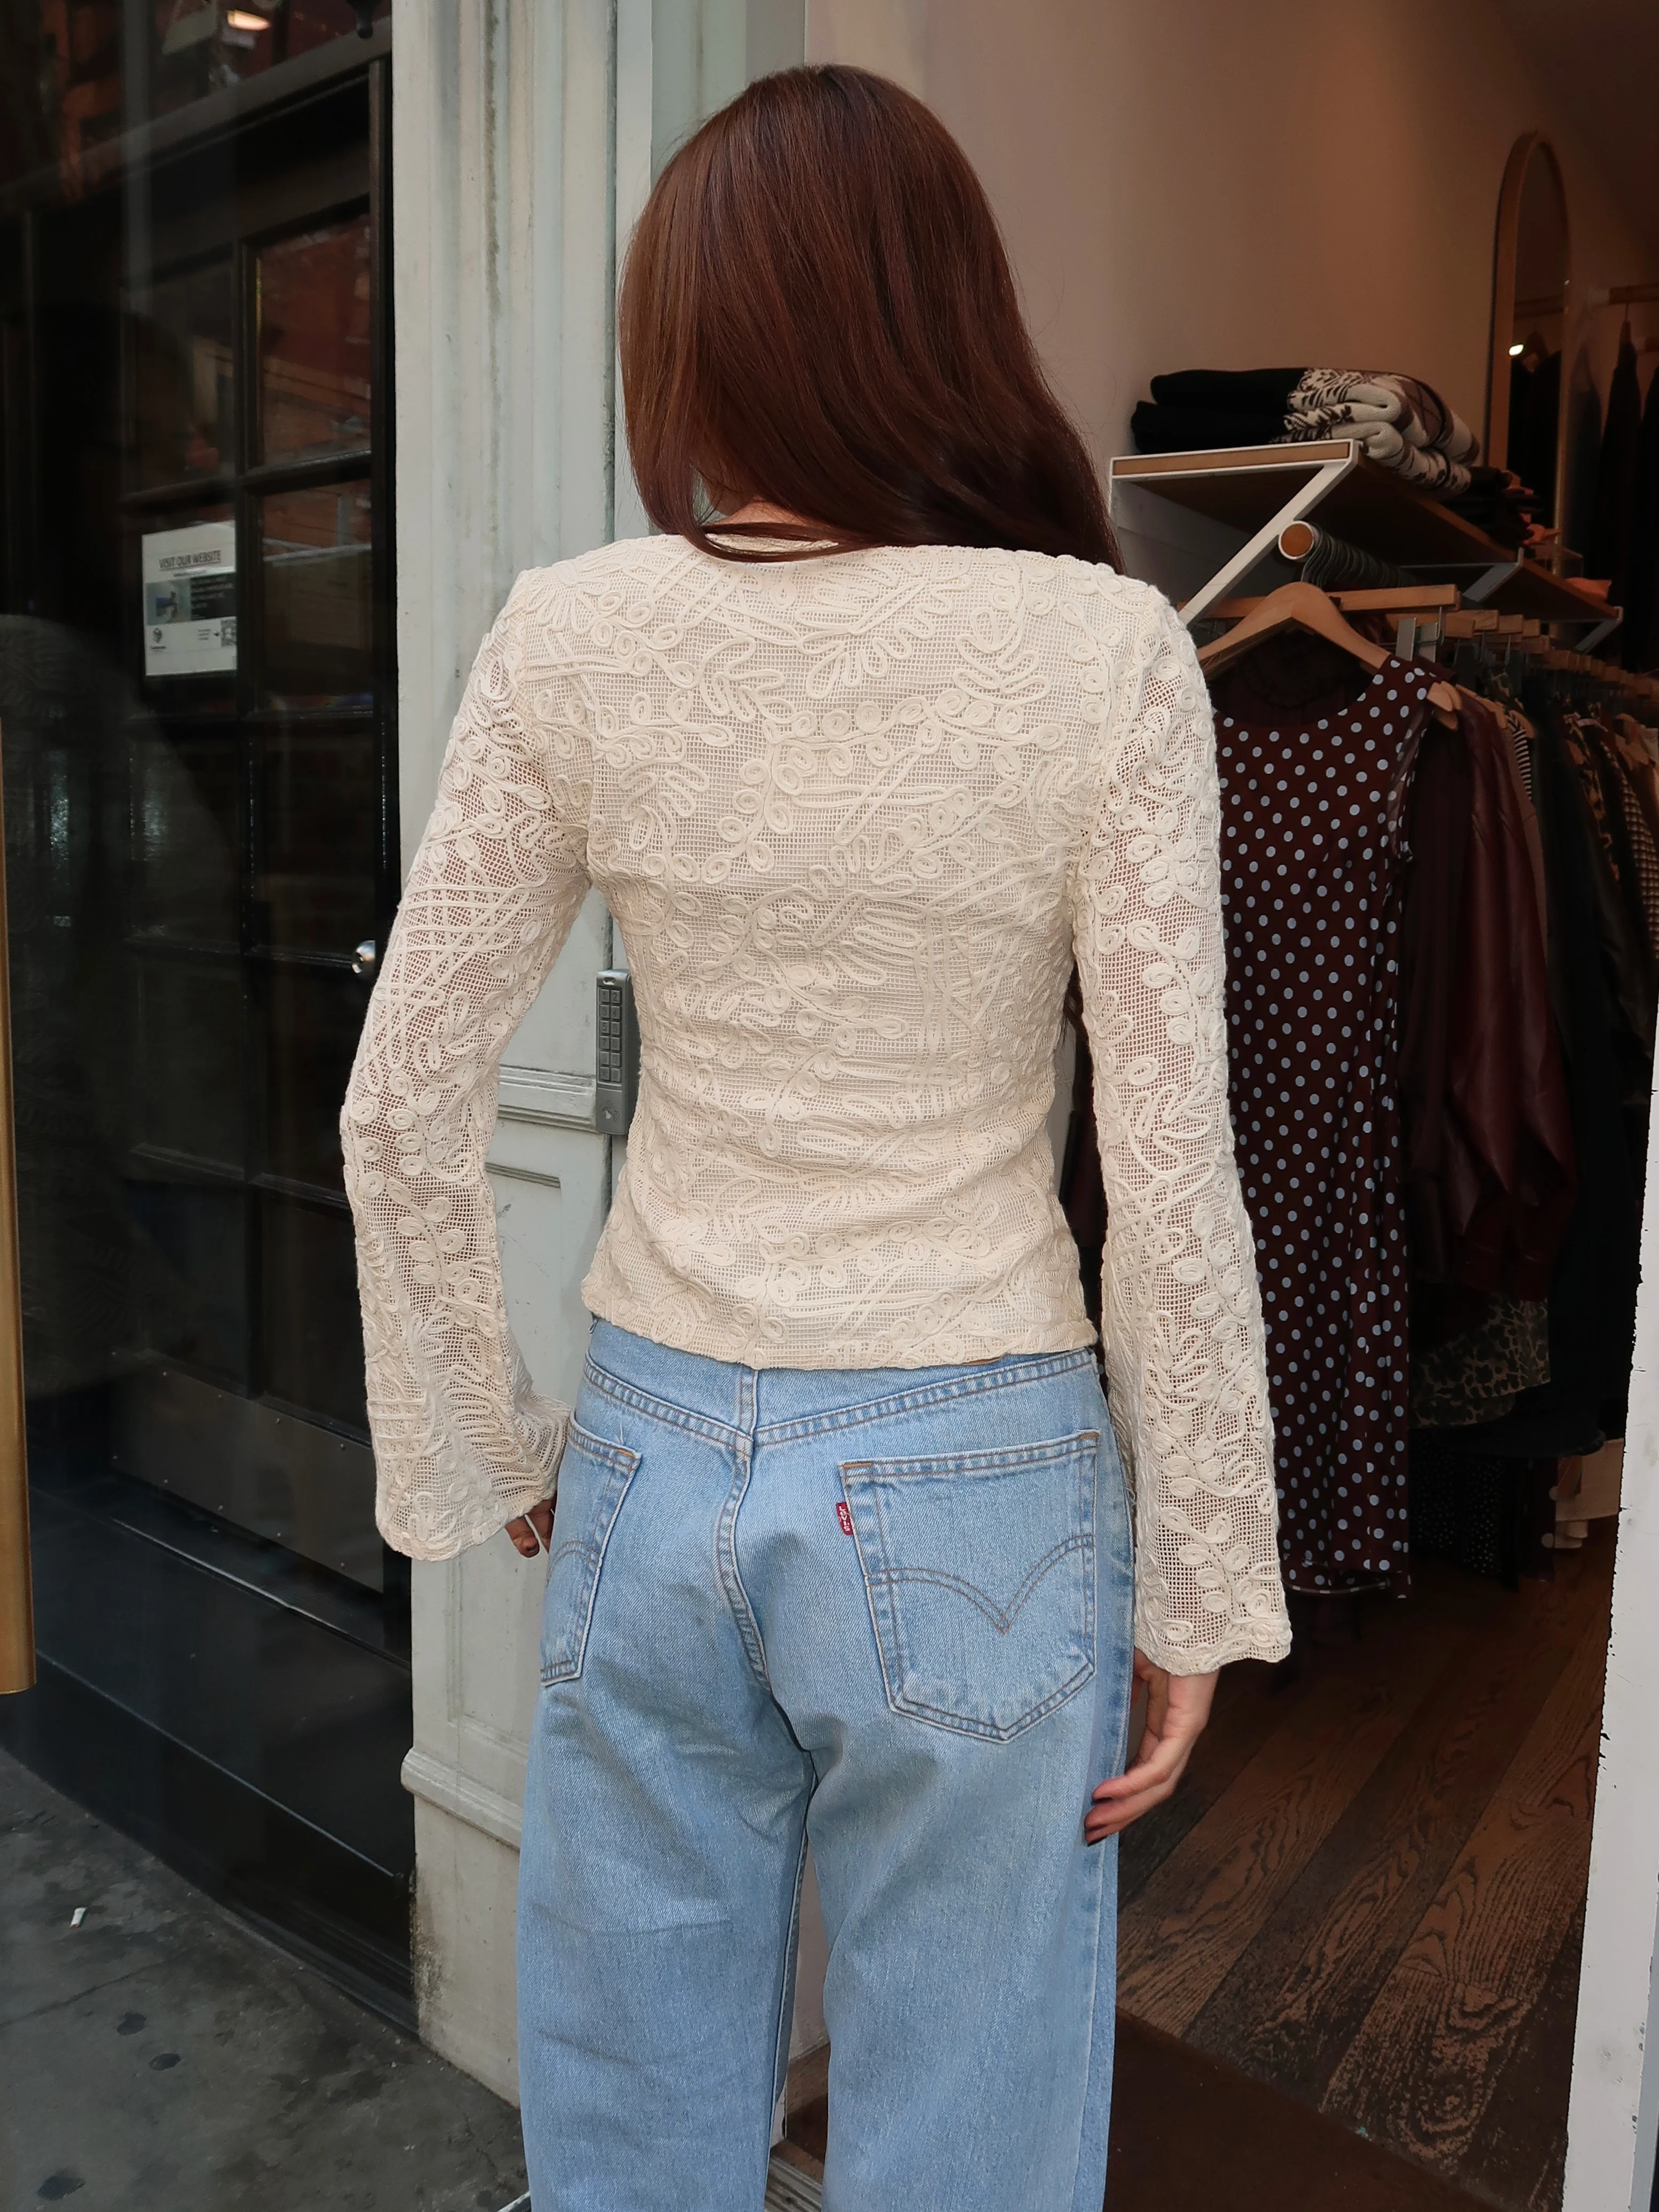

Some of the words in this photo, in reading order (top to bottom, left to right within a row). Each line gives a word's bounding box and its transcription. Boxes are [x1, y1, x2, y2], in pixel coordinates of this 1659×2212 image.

[159, 557, 175, 568] VISIT
[177, 555, 191, 566] OUR
[193, 550, 221, 563] WEBSITE
